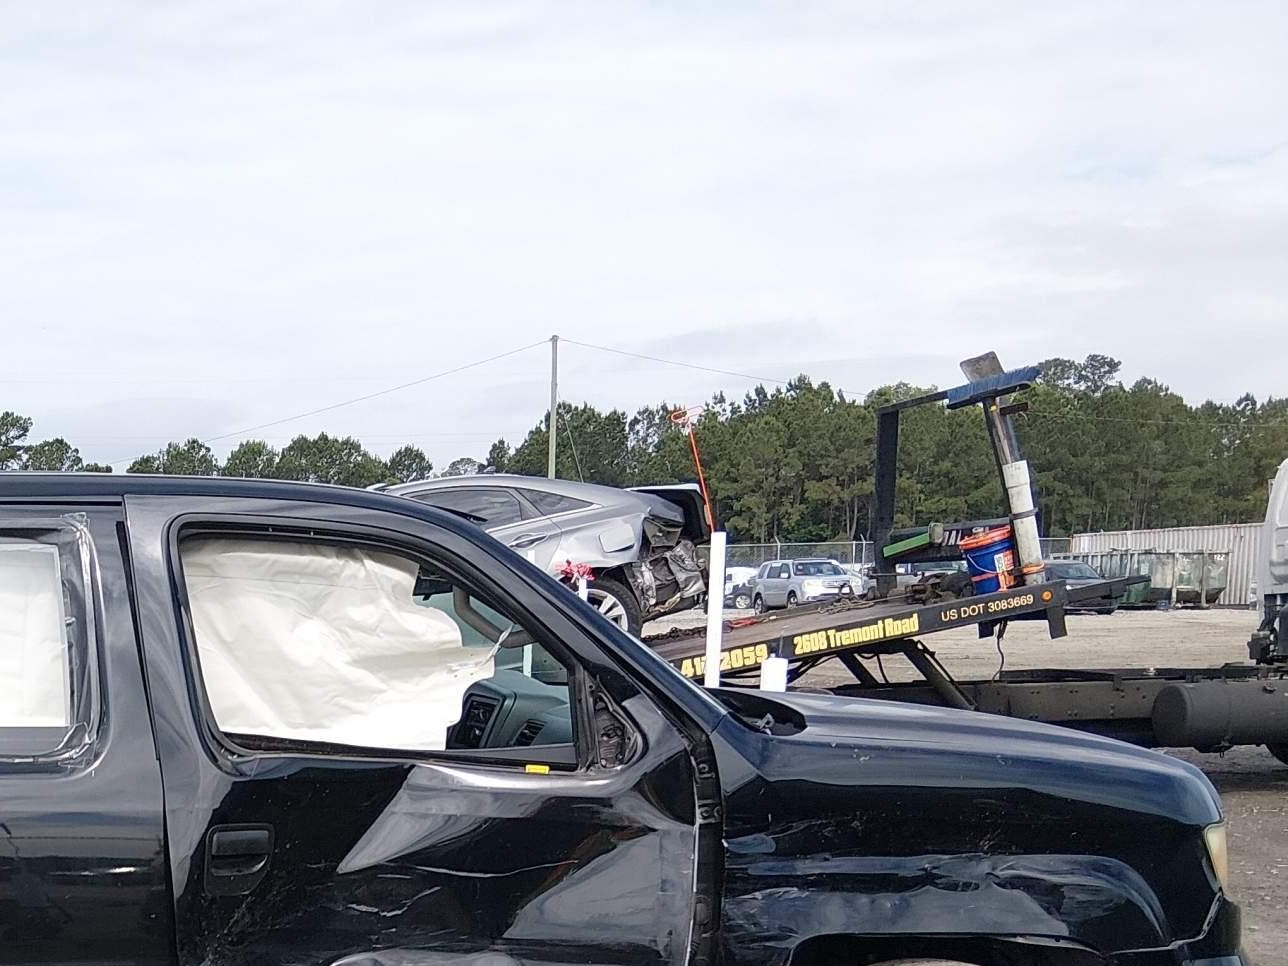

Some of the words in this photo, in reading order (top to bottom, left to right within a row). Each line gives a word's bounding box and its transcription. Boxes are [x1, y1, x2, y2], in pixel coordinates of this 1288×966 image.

[941, 609, 958, 622] US
[960, 603, 985, 618] DOT
[987, 594, 1034, 612] 3083669
[793, 630, 828, 655] 2608
[827, 620, 884, 648] Tremont
[884, 613, 919, 637] Road
[720, 643, 768, 671] 2059
